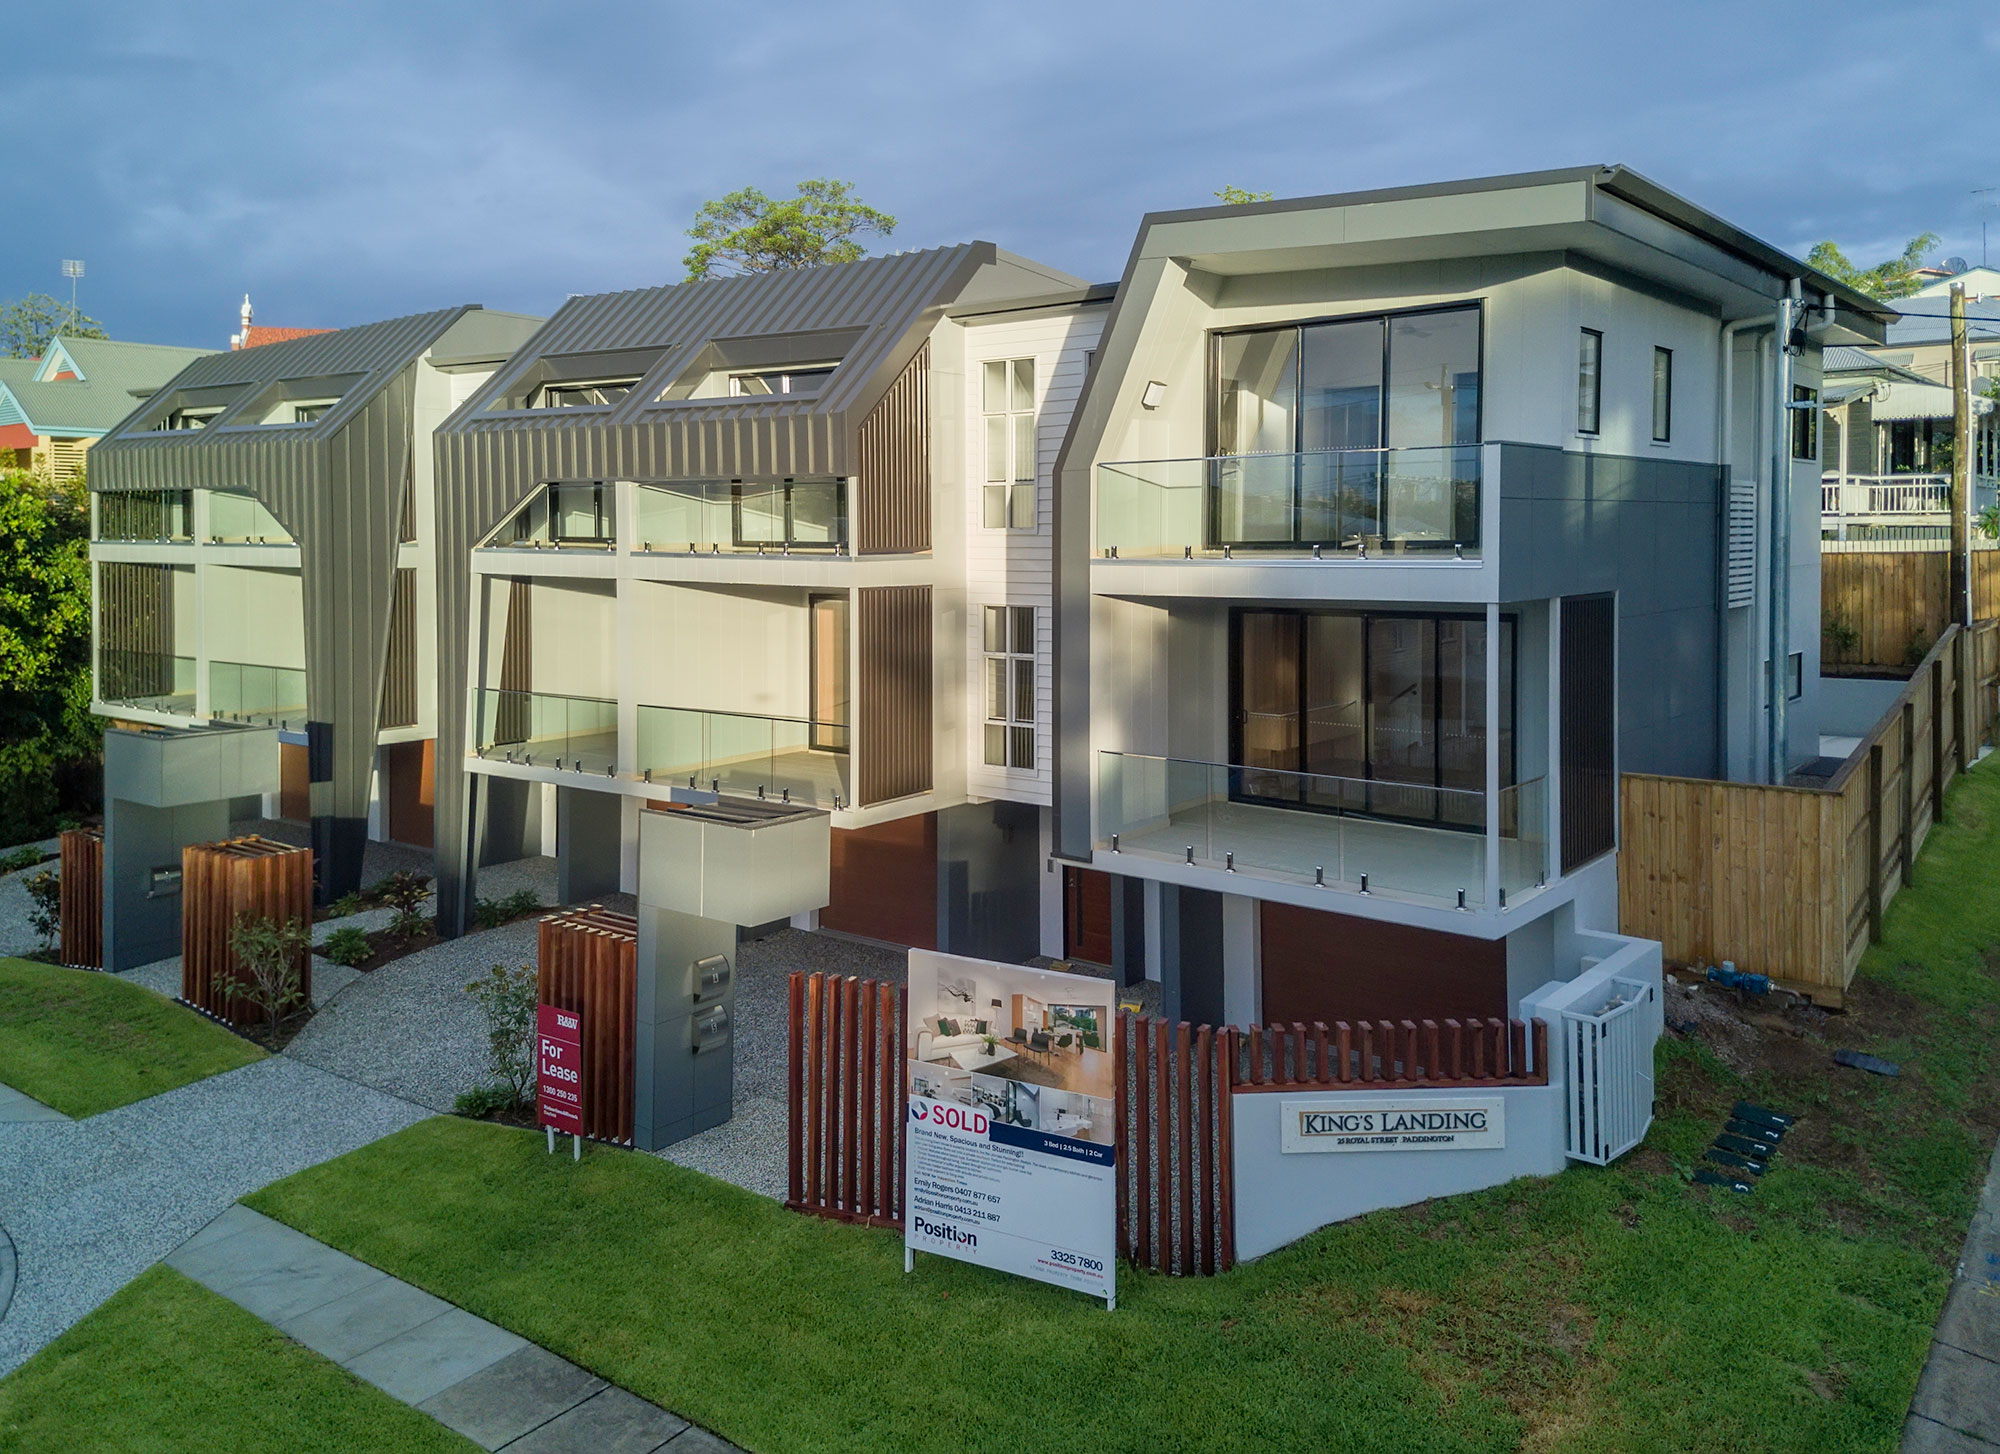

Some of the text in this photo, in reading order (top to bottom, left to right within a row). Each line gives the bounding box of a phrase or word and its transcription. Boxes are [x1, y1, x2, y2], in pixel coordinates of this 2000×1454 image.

[557, 1014, 578, 1029] R&W
[542, 1039, 563, 1059] For
[542, 1058, 578, 1083] Lease
[543, 1085, 556, 1095] 1300
[556, 1089, 567, 1099] 250
[933, 1105, 988, 1134] SOLD
[914, 1127, 932, 1137] Brand
[934, 1131, 948, 1141] New,
[950, 1135, 977, 1147] Spacious
[979, 1142, 991, 1150] and
[1048, 1141, 1058, 1149] Bed
[1072, 1146, 1084, 1154] Bath
[1093, 1150, 1103, 1158] Car
[1370, 1136, 1398, 1144] STREET
[1402, 1135, 1455, 1143] PADDINGTON
[914, 1177, 1001, 1204] Emily Rogers 0407 877 657
[1735, 1183, 1749, 1192] 5
[914, 1195, 1001, 1222] Adrian Harris 0413 211 887
[914, 1216, 977, 1247] Position
[914, 1233, 977, 1255] PROPERTY
[1051, 1250, 1103, 1272] 3325 7800
